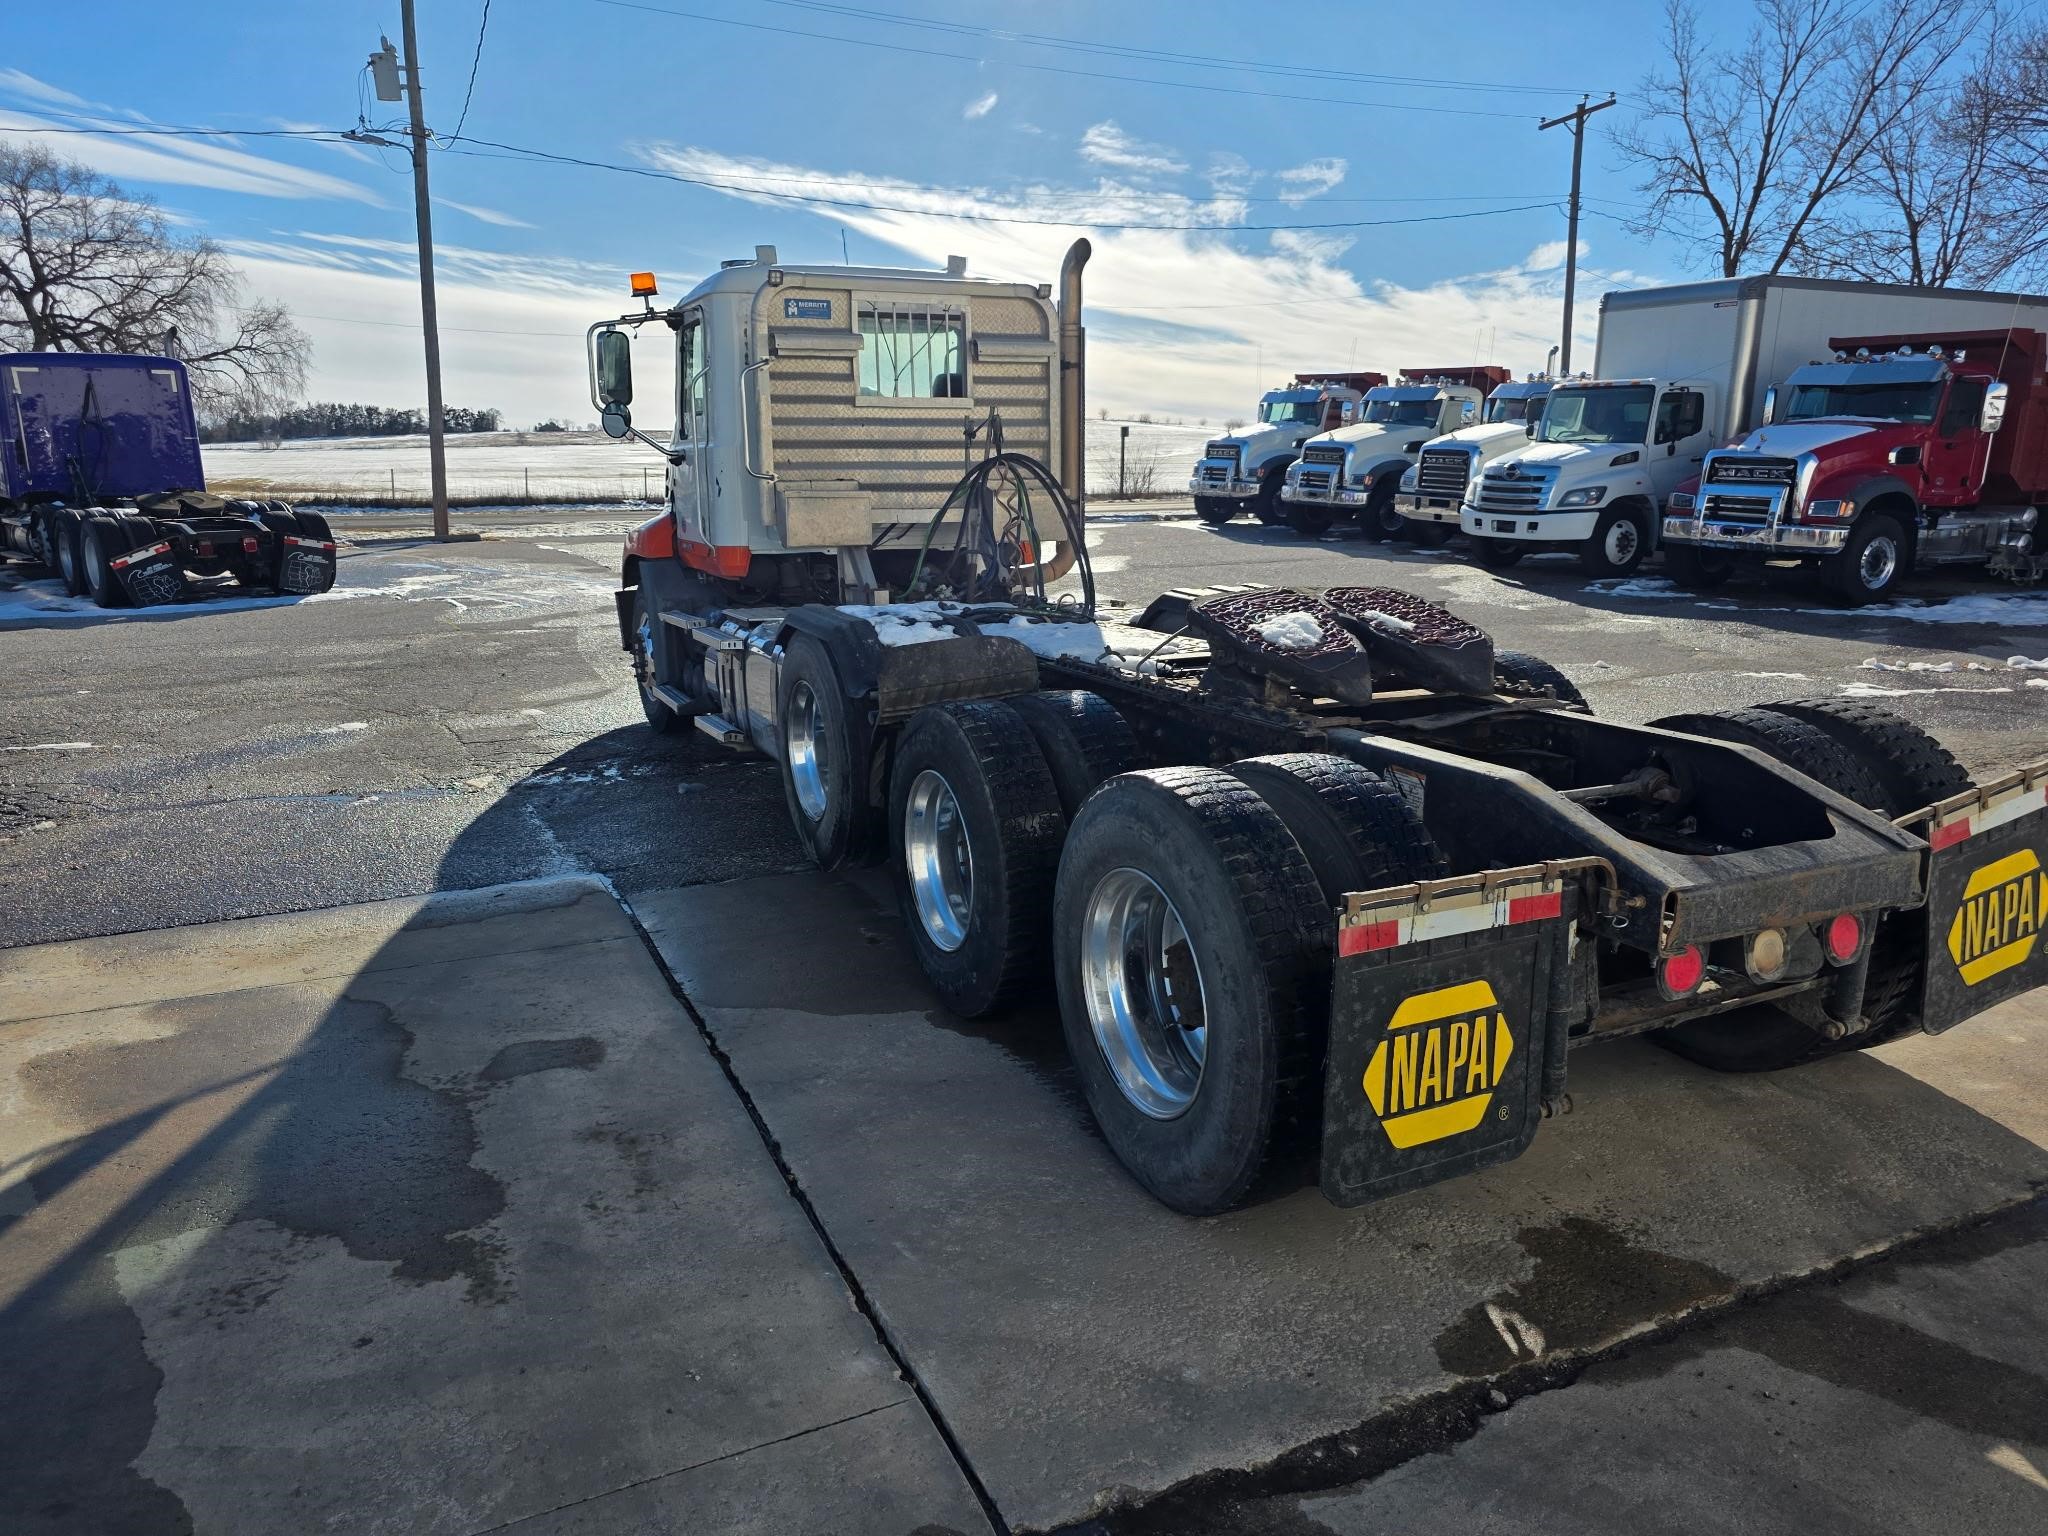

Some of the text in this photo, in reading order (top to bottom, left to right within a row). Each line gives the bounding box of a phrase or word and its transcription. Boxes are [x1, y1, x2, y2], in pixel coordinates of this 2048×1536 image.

[1718, 469, 1787, 478] MACK
[1965, 876, 2034, 961] NAPA
[1391, 1016, 1487, 1113] NAPA
